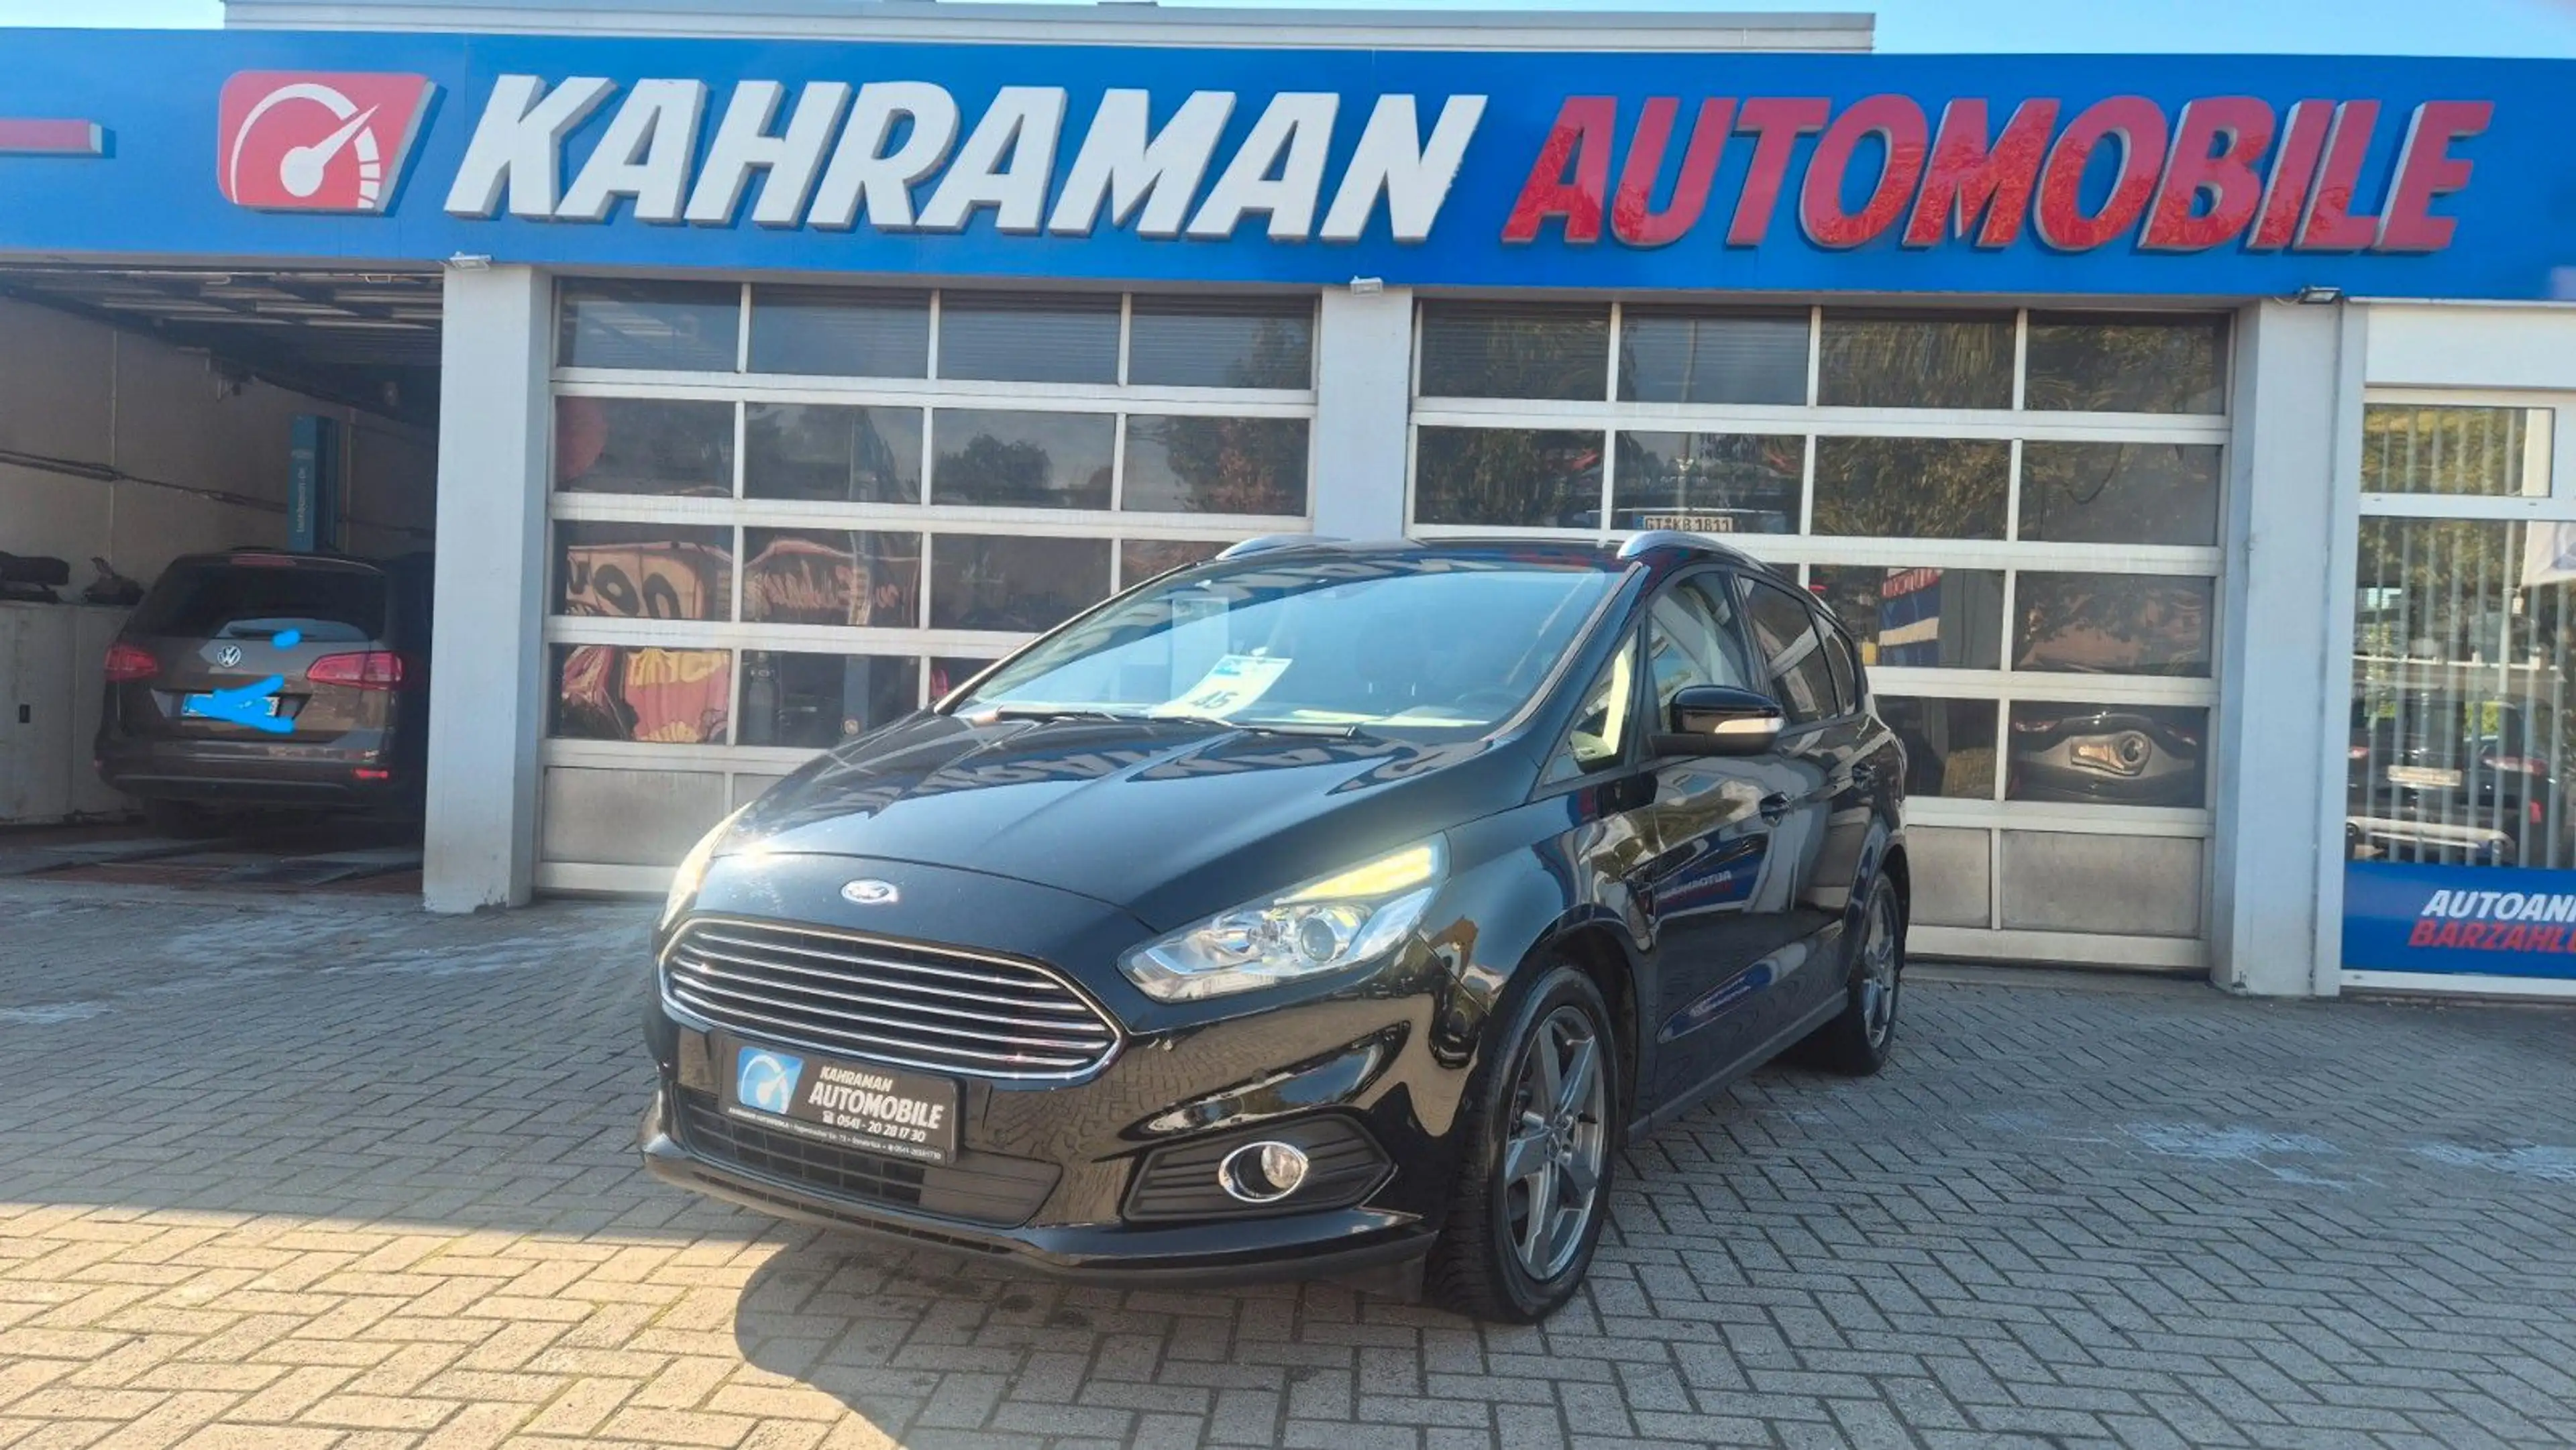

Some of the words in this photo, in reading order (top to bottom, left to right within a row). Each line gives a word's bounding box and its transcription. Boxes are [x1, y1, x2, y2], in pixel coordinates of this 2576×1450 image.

[444, 74, 1488, 242] KAHRAMAN
[1501, 93, 2494, 254] AUTOMOBILE
[820, 1066, 894, 1092] KAHRAMAN
[808, 1081, 945, 1129] AUTOMOBILE
[837, 1113, 861, 1129] 0541
[867, 1120, 882, 1133] 20
[883, 1123, 898, 1137] 28
[910, 1129, 926, 1143] 30
